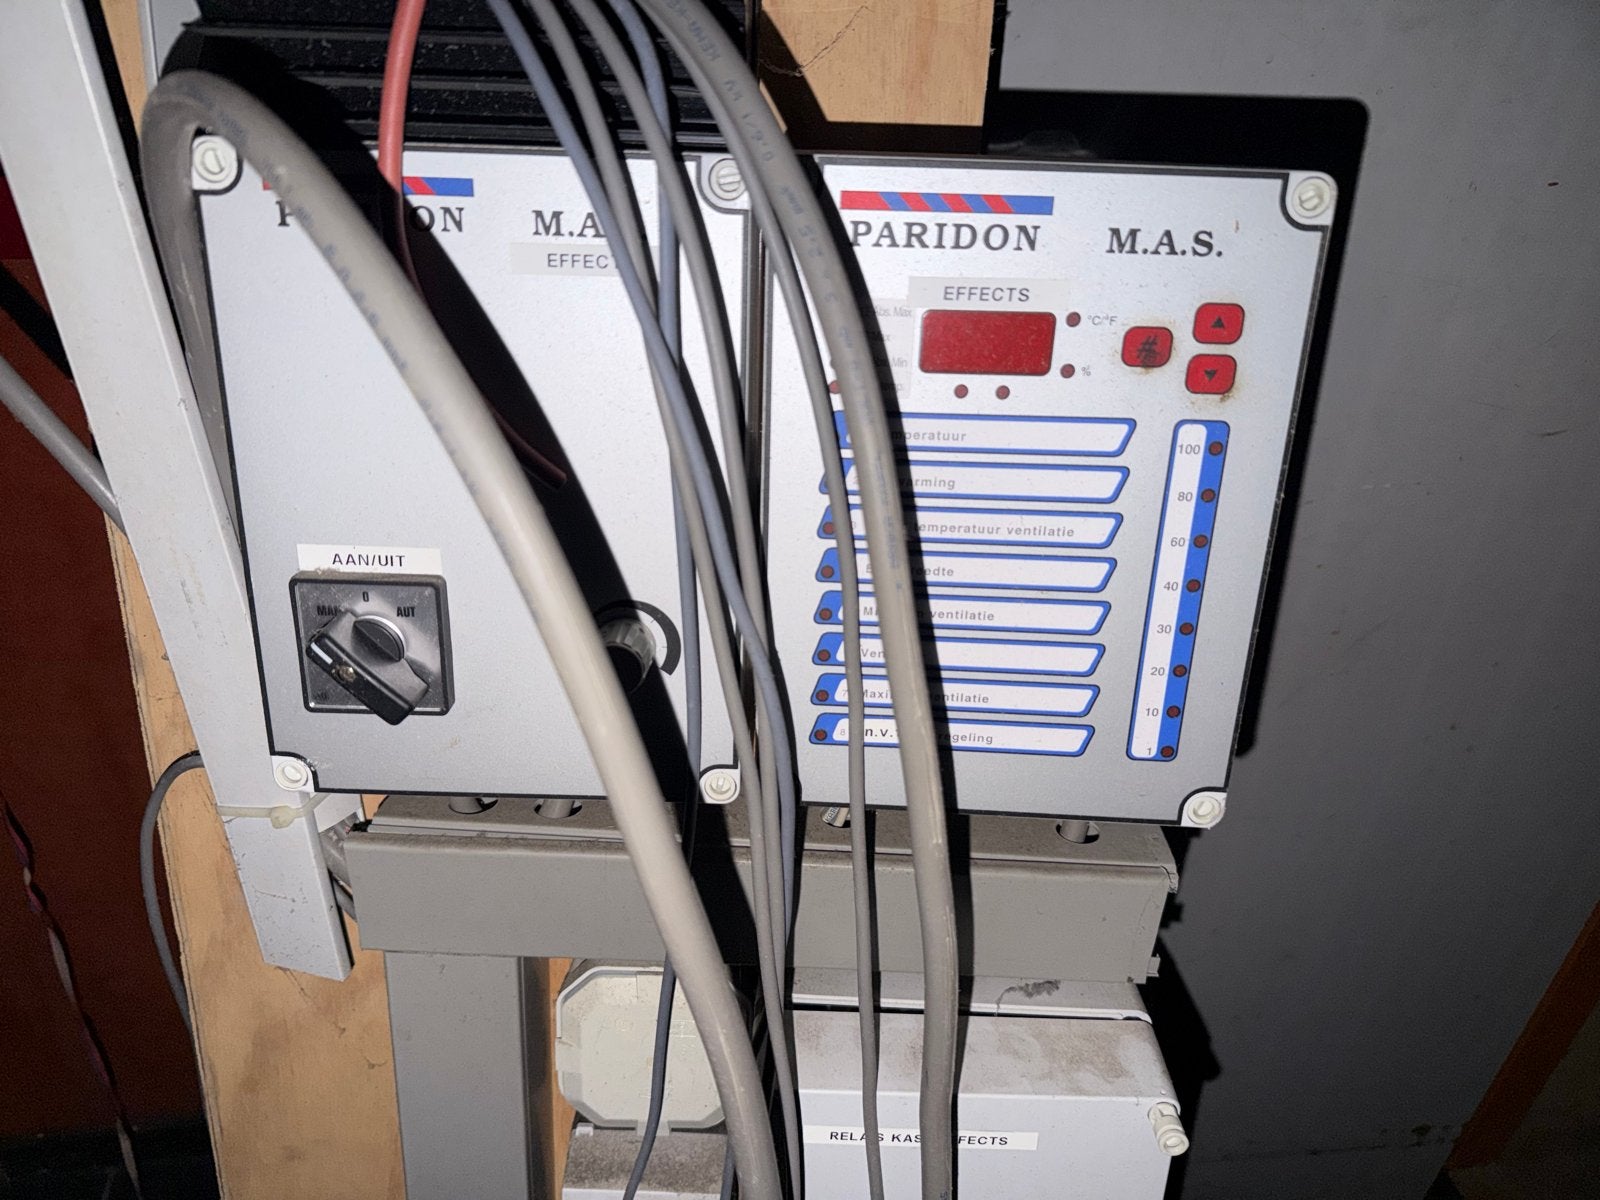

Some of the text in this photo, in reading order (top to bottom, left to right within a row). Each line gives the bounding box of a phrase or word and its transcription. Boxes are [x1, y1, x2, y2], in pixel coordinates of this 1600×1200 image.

[532, 209, 606, 238] M.A
[849, 220, 1223, 257] PARIDON M.A.S.
[547, 253, 612, 269] EFFEC
[943, 285, 1031, 302] EFFECTS
[1178, 444, 1201, 455] 100
[1177, 491, 1194, 502] 80
[1007, 525, 1075, 537] ventilatie
[1170, 536, 1186, 547] 60
[332, 553, 406, 567] AAN/UIT
[1163, 581, 1179, 592] 40
[396, 606, 416, 617] AUT
[930, 609, 996, 621] ventilatie
[1156, 624, 1172, 634] 30
[1150, 667, 1165, 677] 20
[1145, 708, 1159, 717] 10
[1146, 747, 1152, 756] 1
[829, 1131, 1009, 1146] RELAS KAS FECTS
